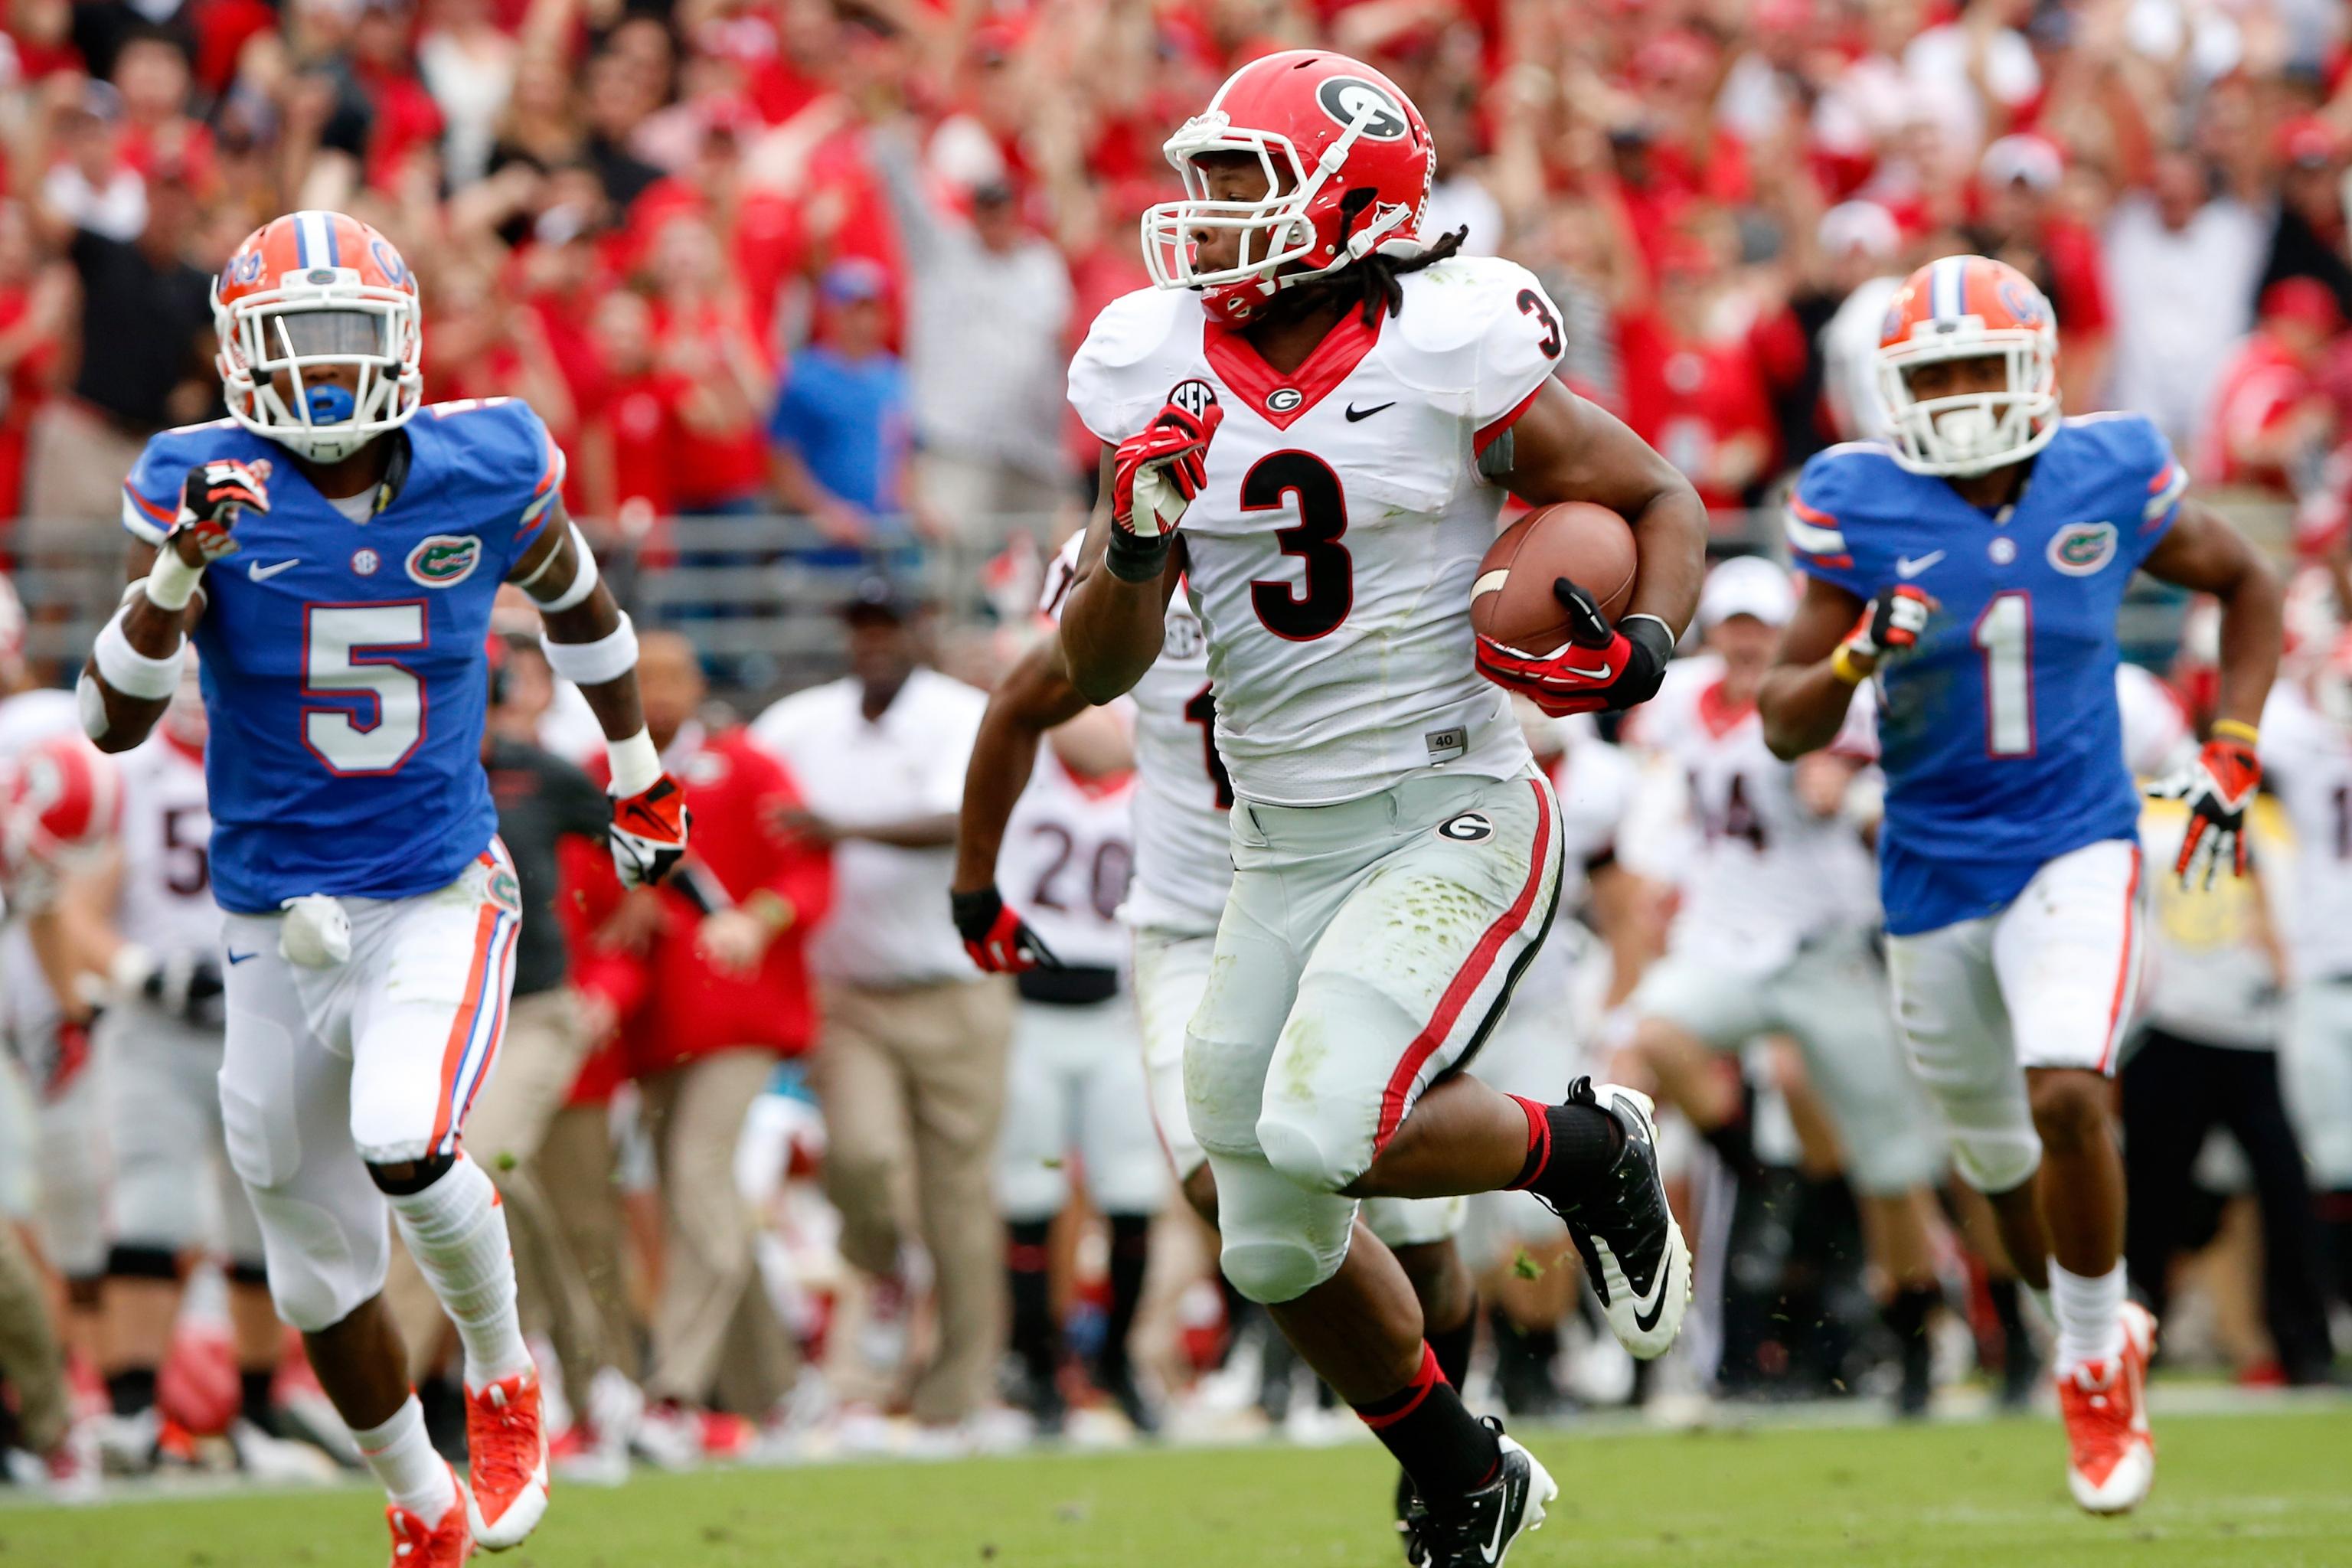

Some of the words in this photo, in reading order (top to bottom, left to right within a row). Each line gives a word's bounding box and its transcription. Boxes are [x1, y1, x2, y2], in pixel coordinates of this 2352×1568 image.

[1516, 289, 1561, 360] 3
[1268, 389, 1302, 411] G
[1240, 449, 1353, 642] 3
[301, 596, 429, 777] 5
[1970, 589, 2037, 760] 1
[1436, 734, 1452, 746] 40
[1438, 813, 1491, 841] G
[1031, 821, 1135, 923] 20
